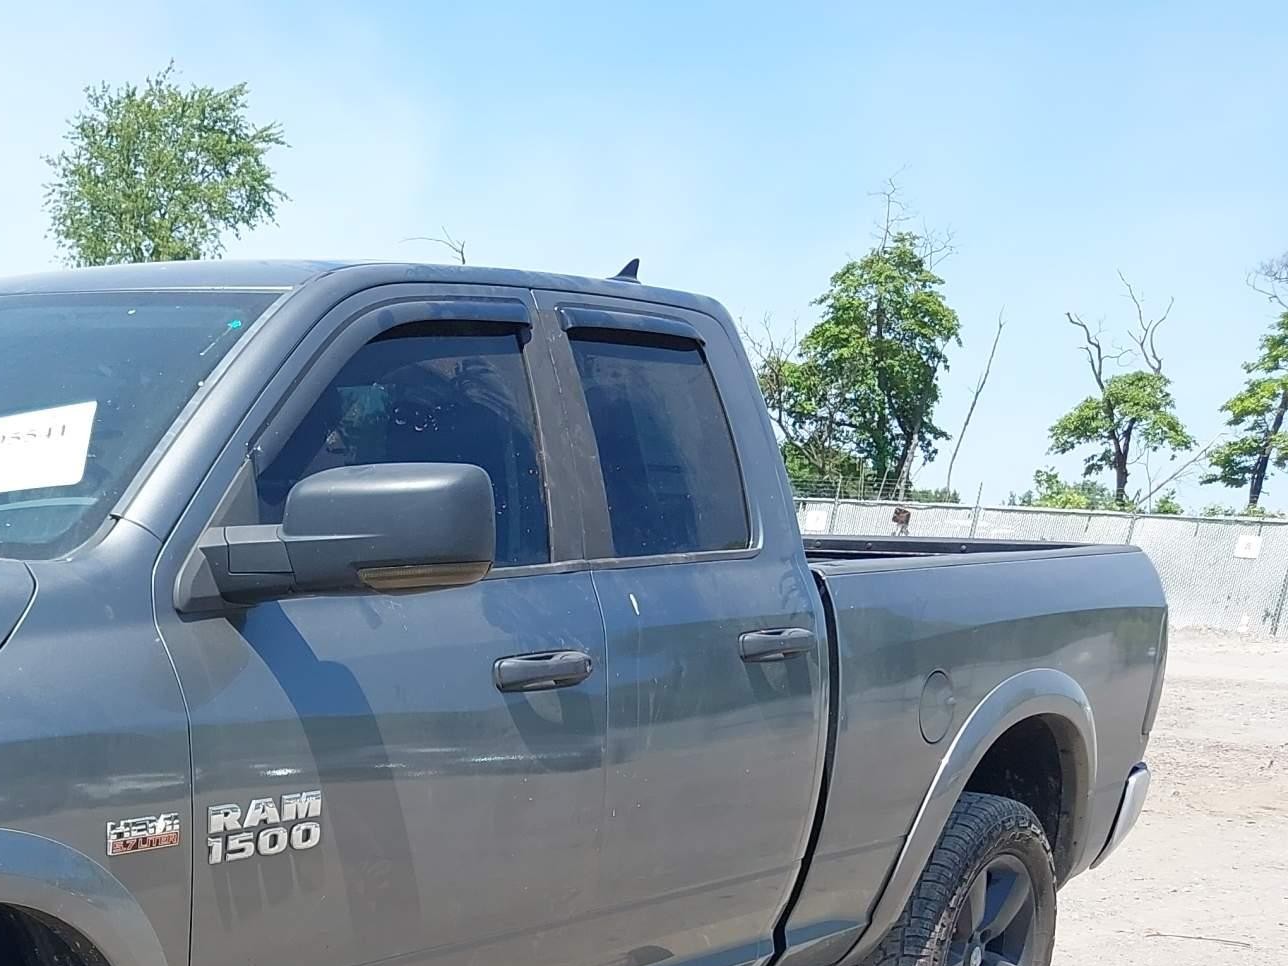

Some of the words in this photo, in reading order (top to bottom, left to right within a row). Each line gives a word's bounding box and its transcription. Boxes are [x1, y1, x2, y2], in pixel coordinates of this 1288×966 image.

[107, 813, 180, 840] HEMI
[208, 790, 321, 833] RAM
[113, 840, 137, 853] 5.7
[208, 822, 320, 864] 1500
